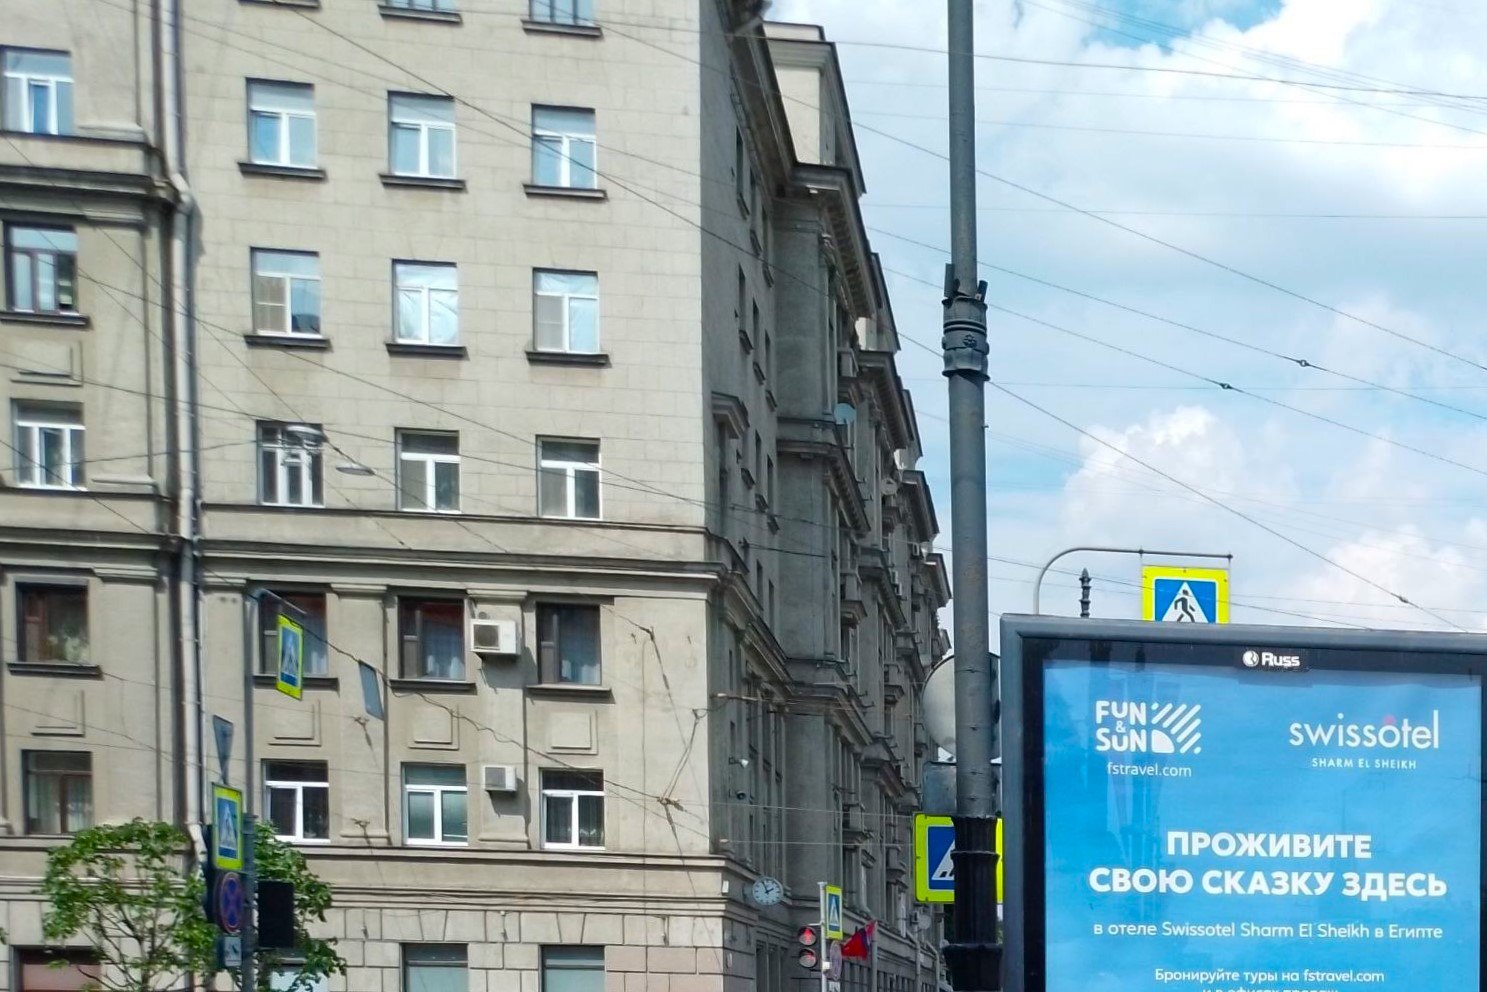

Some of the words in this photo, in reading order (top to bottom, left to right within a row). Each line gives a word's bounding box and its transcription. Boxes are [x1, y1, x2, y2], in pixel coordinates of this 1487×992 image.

[1261, 652, 1300, 667] Russ
[1096, 700, 1147, 726] FUN
[1095, 727, 1147, 752] SUN
[1107, 761, 1192, 777] fstravel.com
[1311, 757, 1354, 768] SHARM
[1358, 758, 1370, 769] EL
[1374, 759, 1417, 770] SHEIKH
[1167, 831, 1372, 859] ПРОЖИВИТЕ
[1089, 867, 1194, 894] СВОЮ
[1201, 869, 1335, 896] СКАЗКУ
[1341, 872, 1448, 902] ЗДЕСЬ
[1093, 924, 1103, 935] в
[1108, 924, 1157, 936] отеле
[1162, 922, 1235, 937] Swissotel
[1240, 923, 1294, 938] Sharm
[1299, 923, 1313, 938] El
[1317, 924, 1370, 939] Sheikh
[1374, 927, 1384, 938] в
[1389, 924, 1443, 939] Египте
[1155, 969, 1240, 983] Бронируйте
[1243, 971, 1278, 984] туры
[1281, 972, 1300, 982] на
[1303, 969, 1385, 983] fstravel.com
